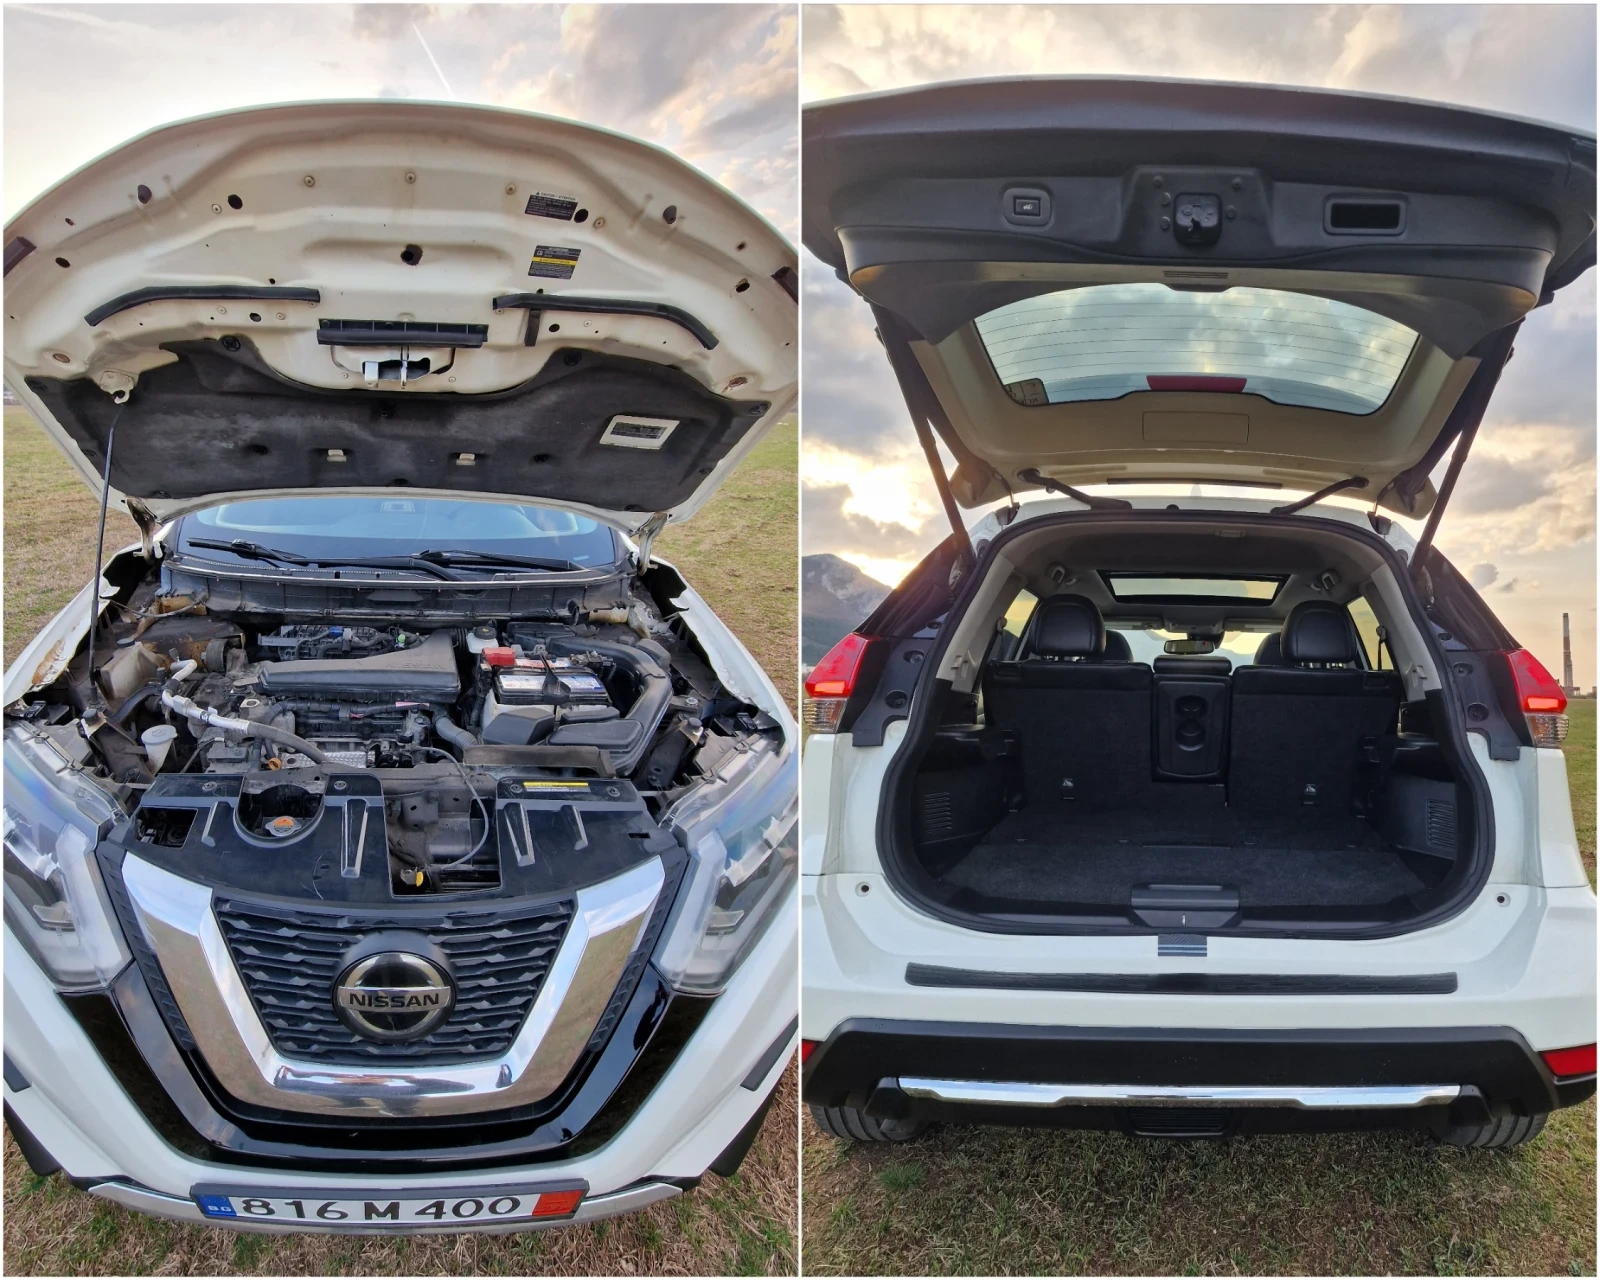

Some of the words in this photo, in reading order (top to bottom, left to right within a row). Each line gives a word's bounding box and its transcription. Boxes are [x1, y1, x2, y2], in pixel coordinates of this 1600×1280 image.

[349, 992, 440, 1008] NISSAN
[207, 1204, 232, 1212] BG
[241, 1198, 349, 1221] 816
[364, 1201, 400, 1221] M
[414, 1196, 521, 1220] 400
